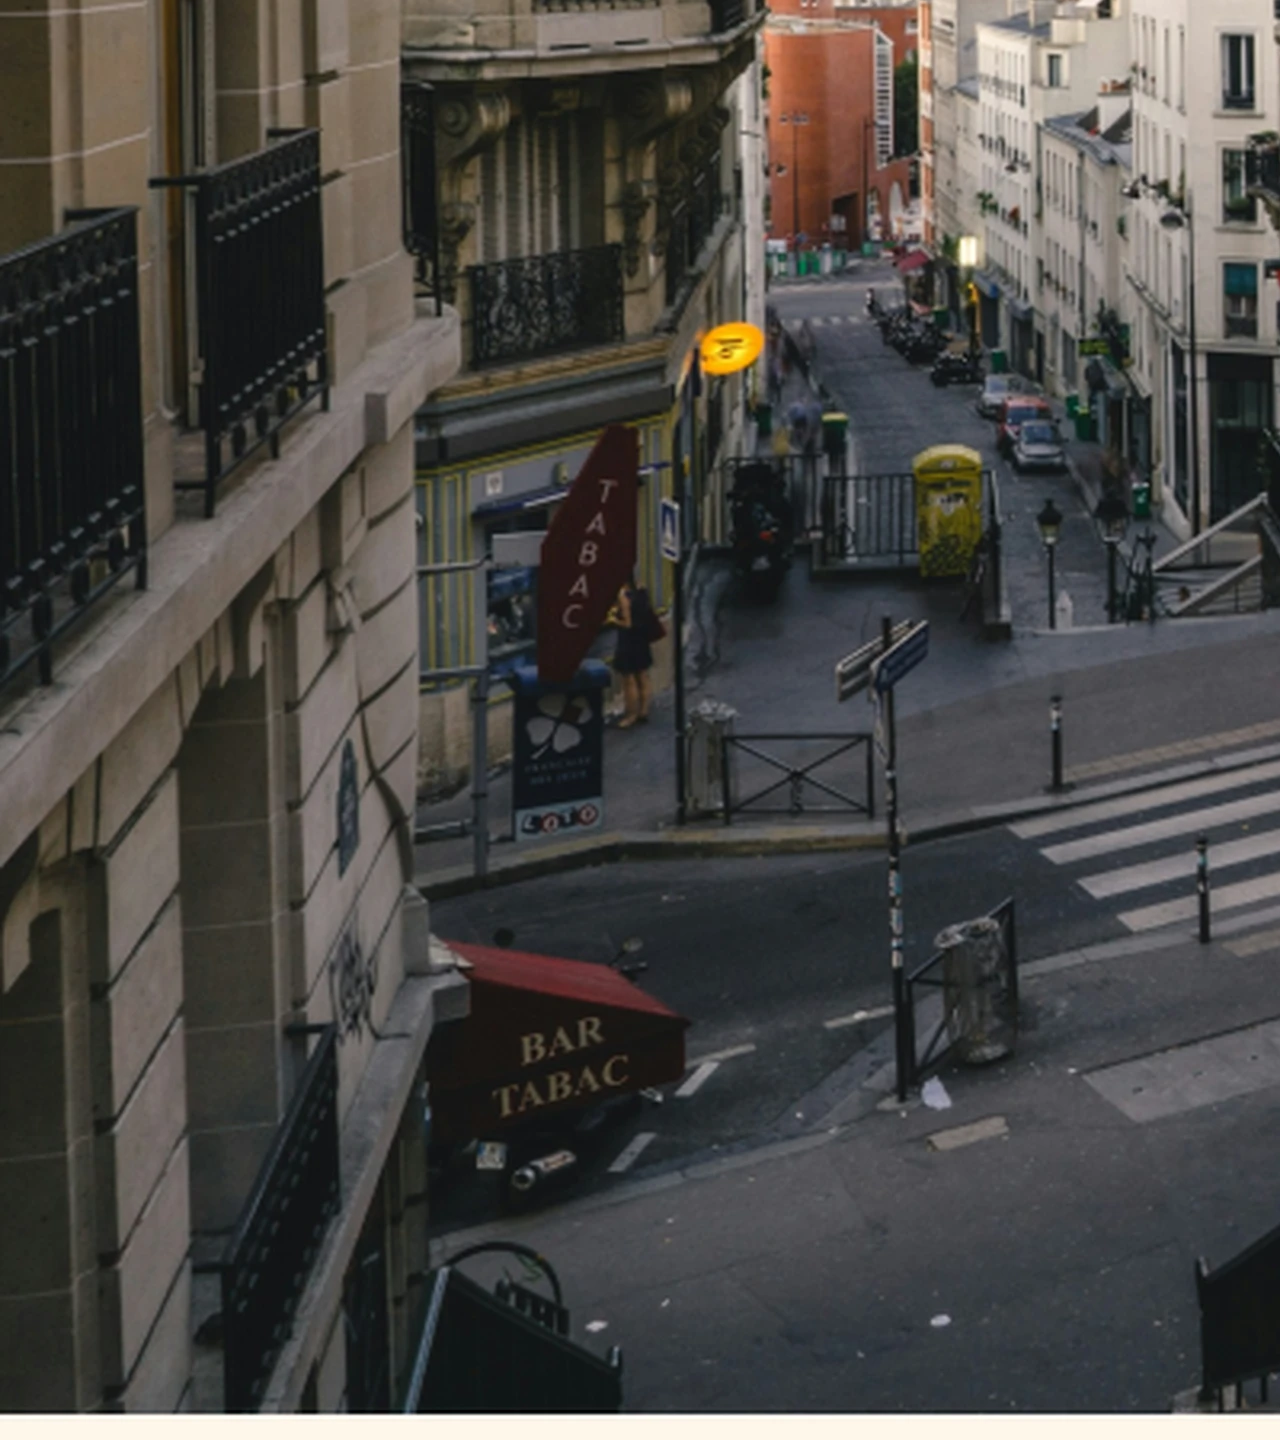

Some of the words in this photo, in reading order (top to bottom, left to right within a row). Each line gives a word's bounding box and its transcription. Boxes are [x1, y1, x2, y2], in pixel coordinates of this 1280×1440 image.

[561, 479, 619, 629] TABAC
[520, 1015, 606, 1066] BAR
[491, 1054, 630, 1119] TABAC
